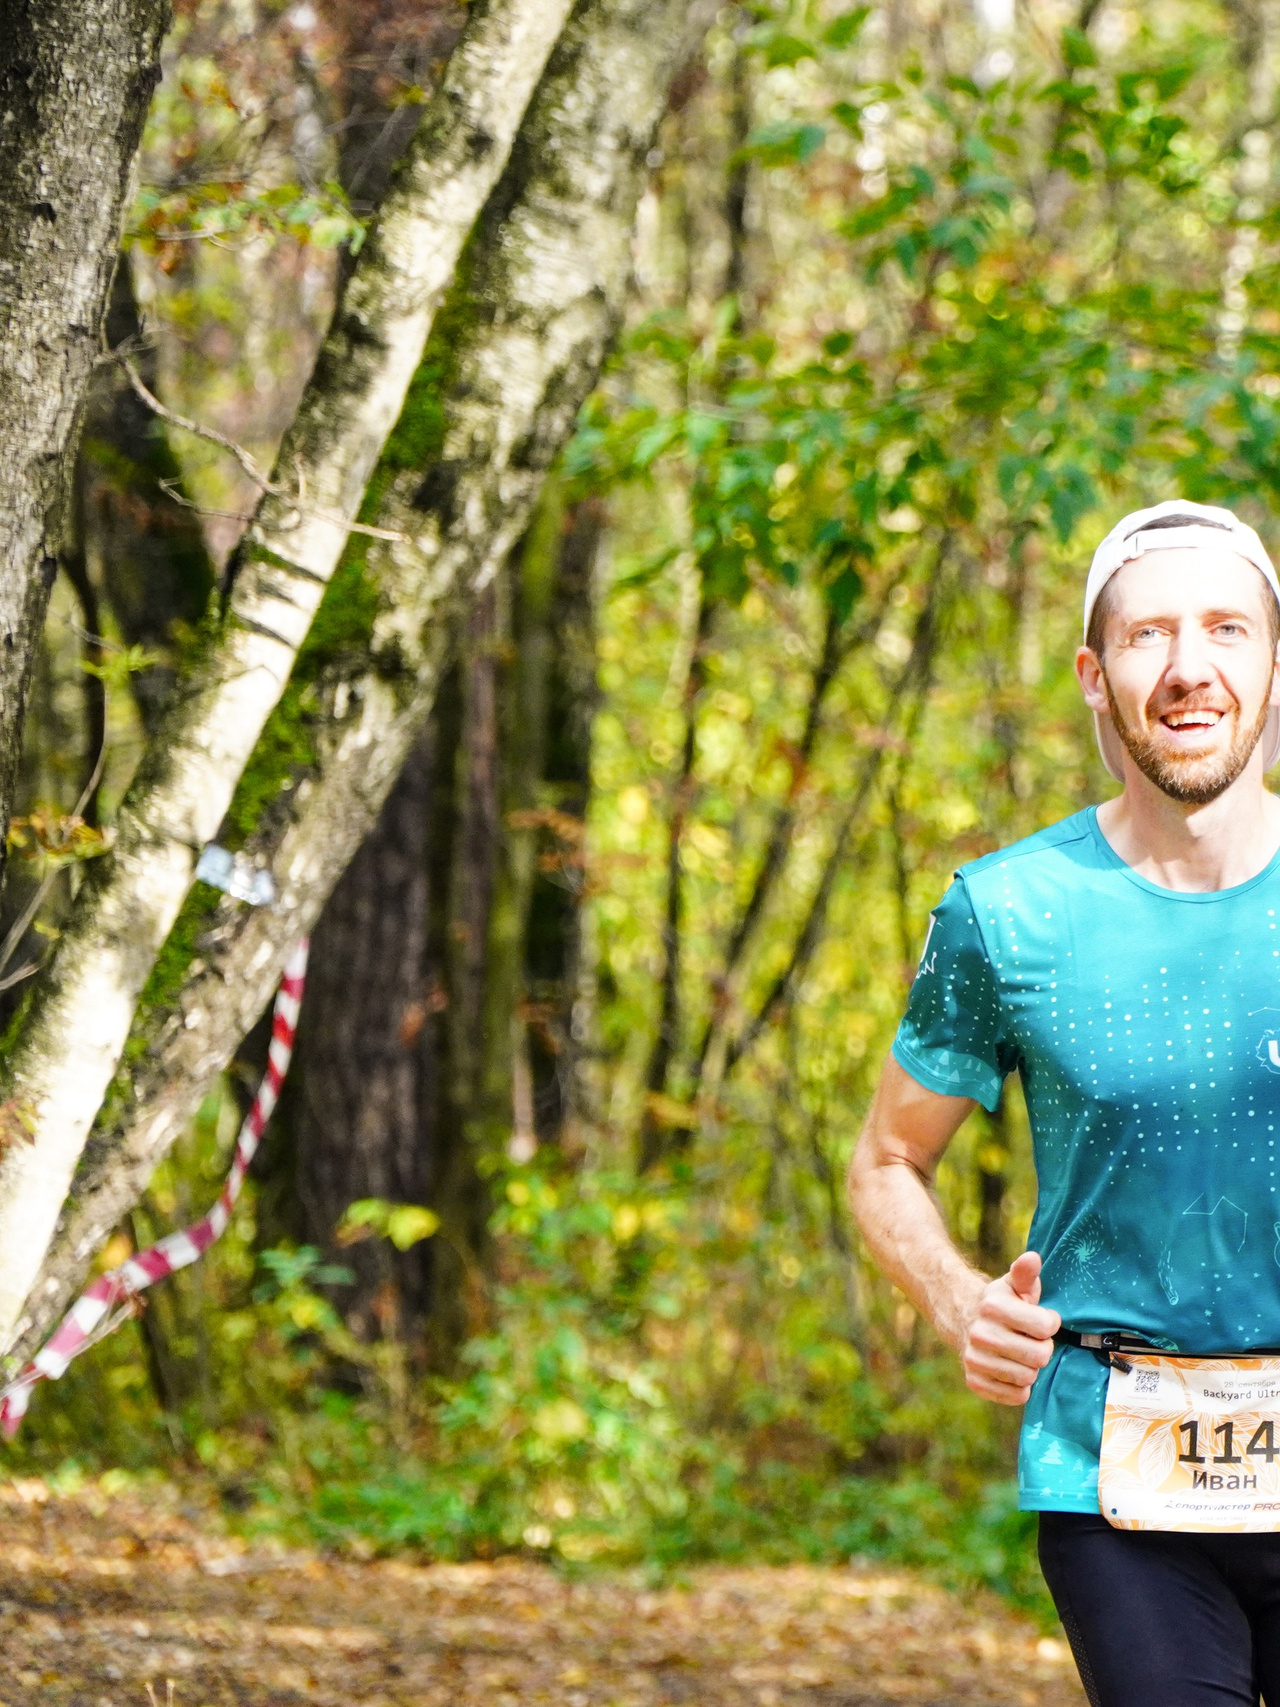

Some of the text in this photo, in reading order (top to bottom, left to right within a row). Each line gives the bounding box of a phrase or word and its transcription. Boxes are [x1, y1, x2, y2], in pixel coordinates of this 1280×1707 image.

[1223, 1380, 1234, 1389] 28
[1238, 1379, 1276, 1389] сентября
[1203, 1388, 1252, 1401] Backyard
[1178, 1420, 1280, 1464] 114
[1192, 1470, 1257, 1491] Иван
